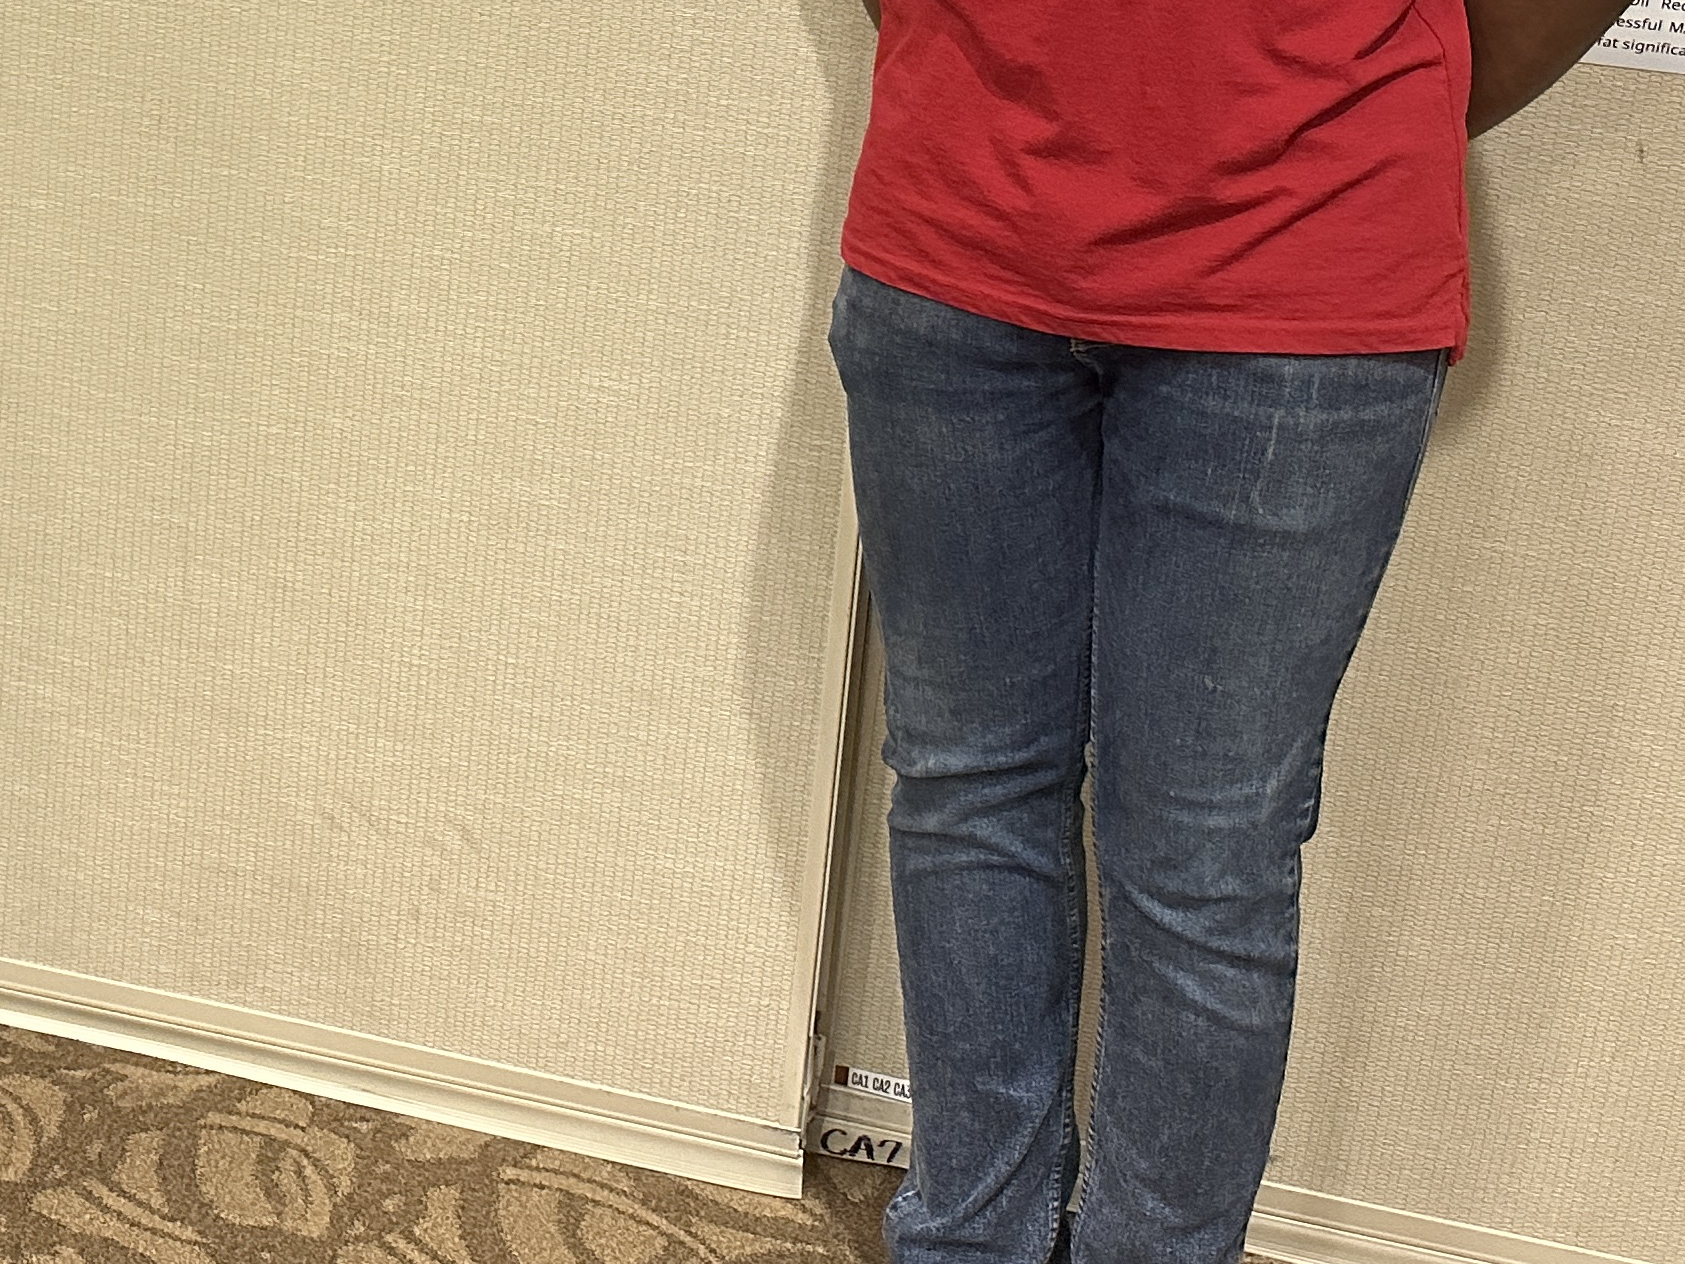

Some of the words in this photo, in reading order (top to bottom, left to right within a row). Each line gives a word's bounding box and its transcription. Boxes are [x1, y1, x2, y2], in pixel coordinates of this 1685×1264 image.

[851, 1072, 869, 1089] CA1
[872, 1077, 891, 1094] CA2
[820, 1128, 903, 1163] CA7
